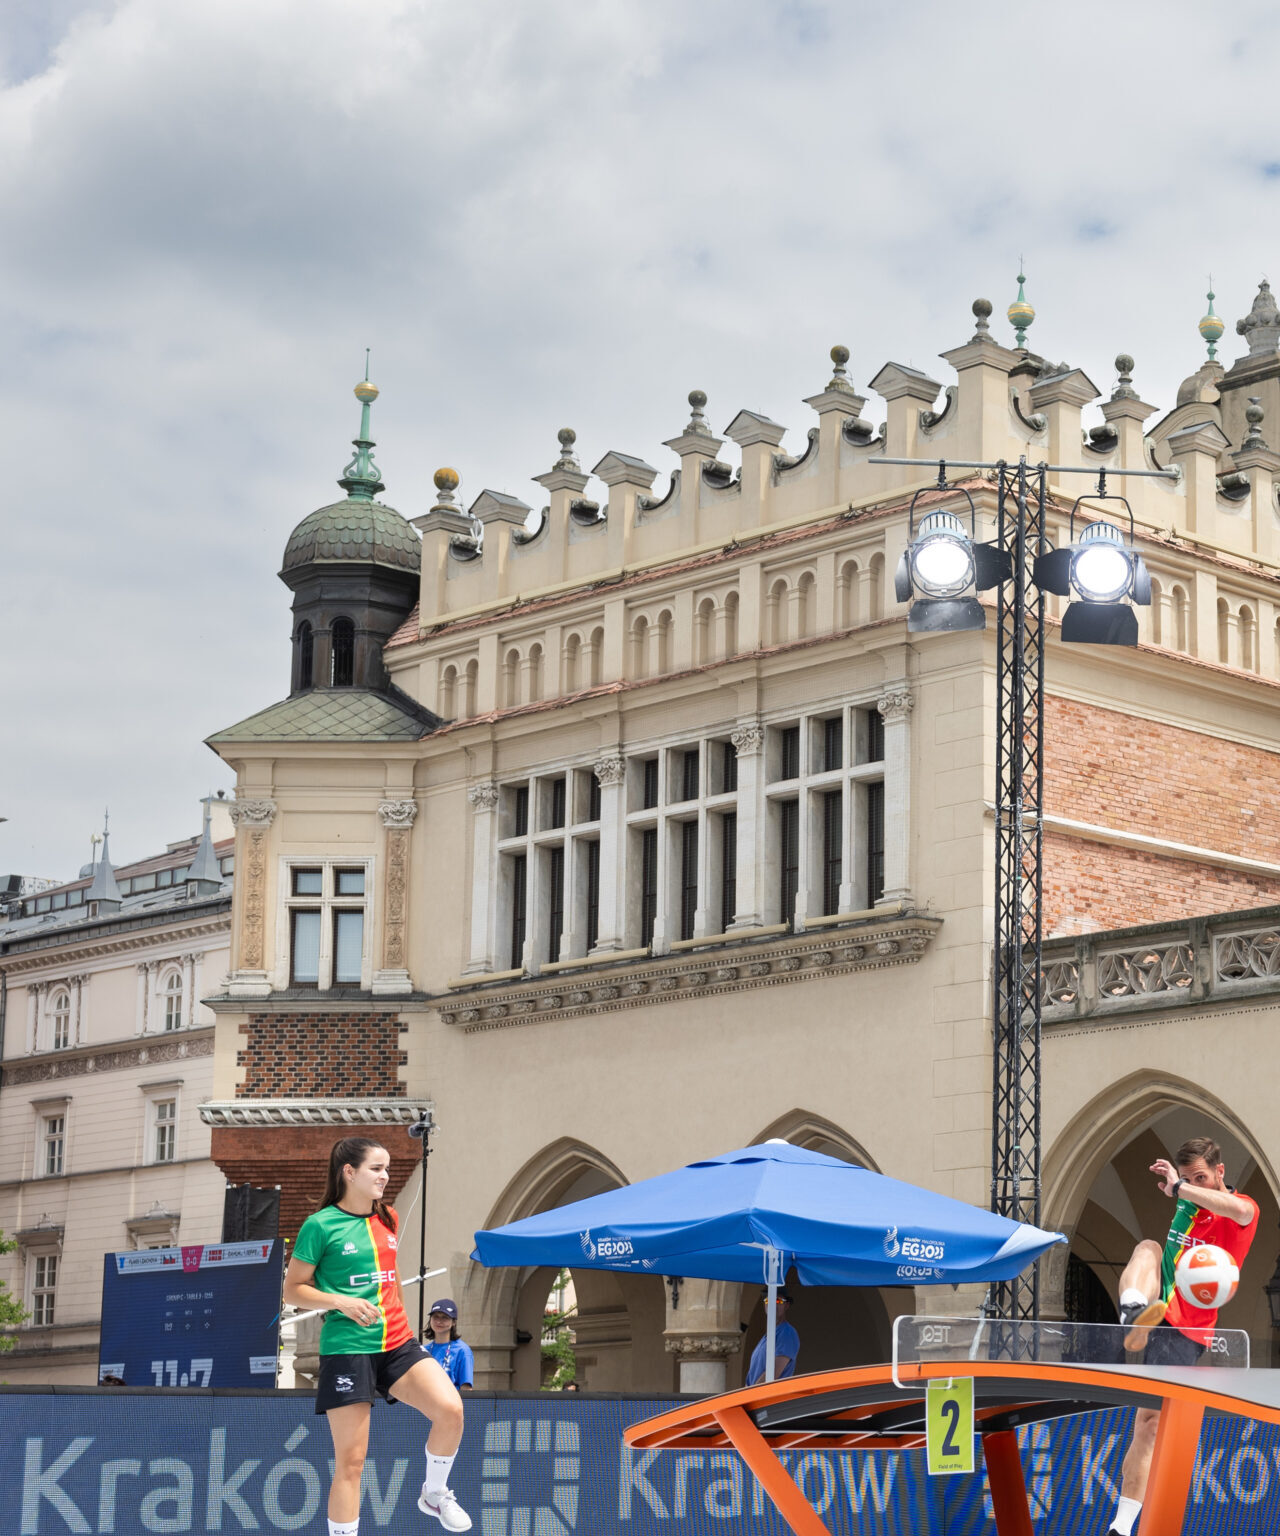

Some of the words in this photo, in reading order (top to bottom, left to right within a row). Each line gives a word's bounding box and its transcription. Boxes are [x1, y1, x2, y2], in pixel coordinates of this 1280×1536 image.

[1203, 1336, 1230, 1357] TEQ
[941, 1399, 960, 1457] 2
[20, 1424, 410, 1535] Kraków
